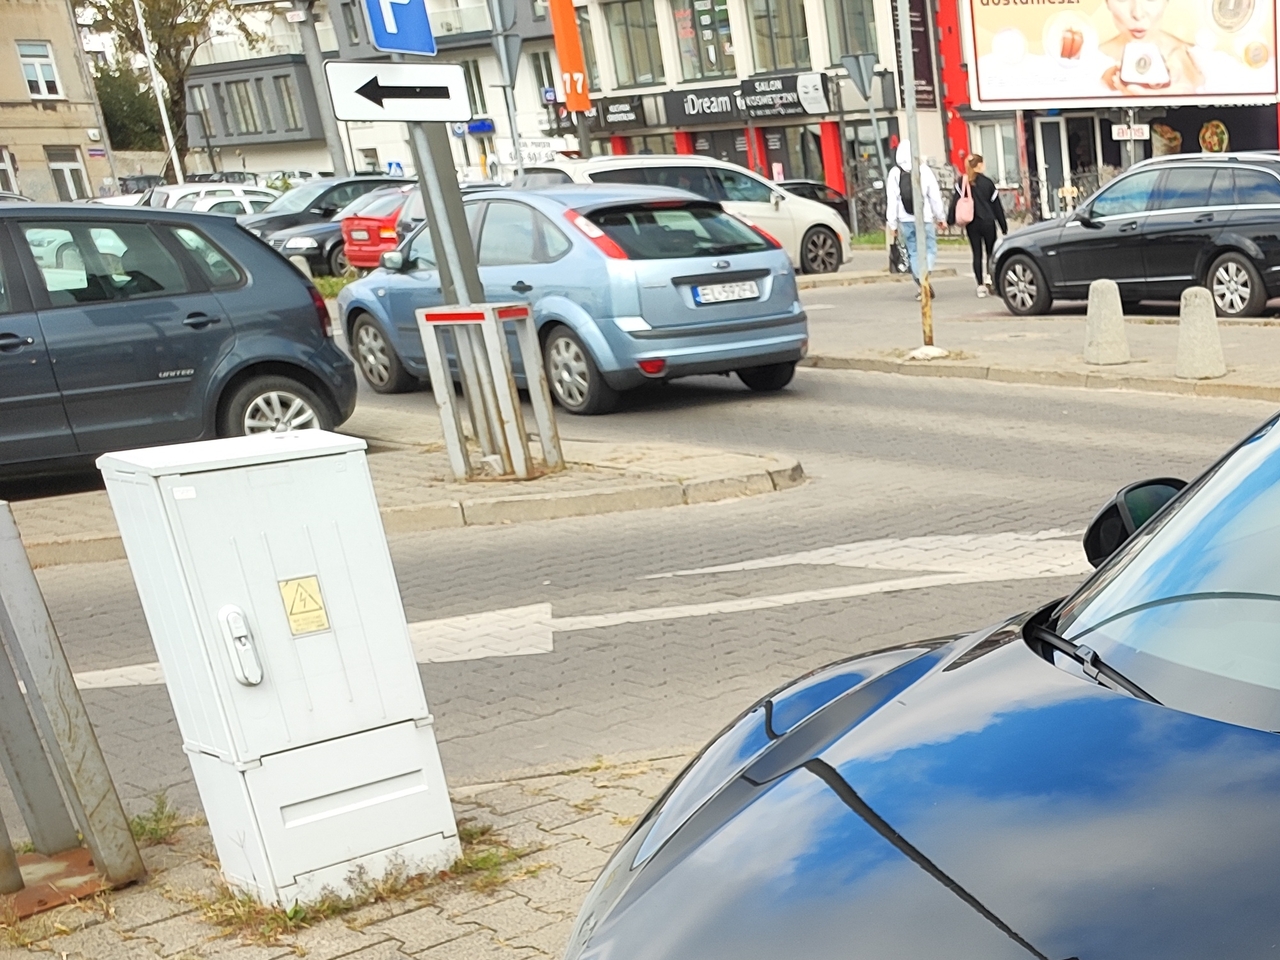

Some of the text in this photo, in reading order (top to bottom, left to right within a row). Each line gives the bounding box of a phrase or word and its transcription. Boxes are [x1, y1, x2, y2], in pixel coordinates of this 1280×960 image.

[562, 72, 585, 94] 17
[754, 79, 783, 93] SALON
[683, 94, 732, 115] iDream
